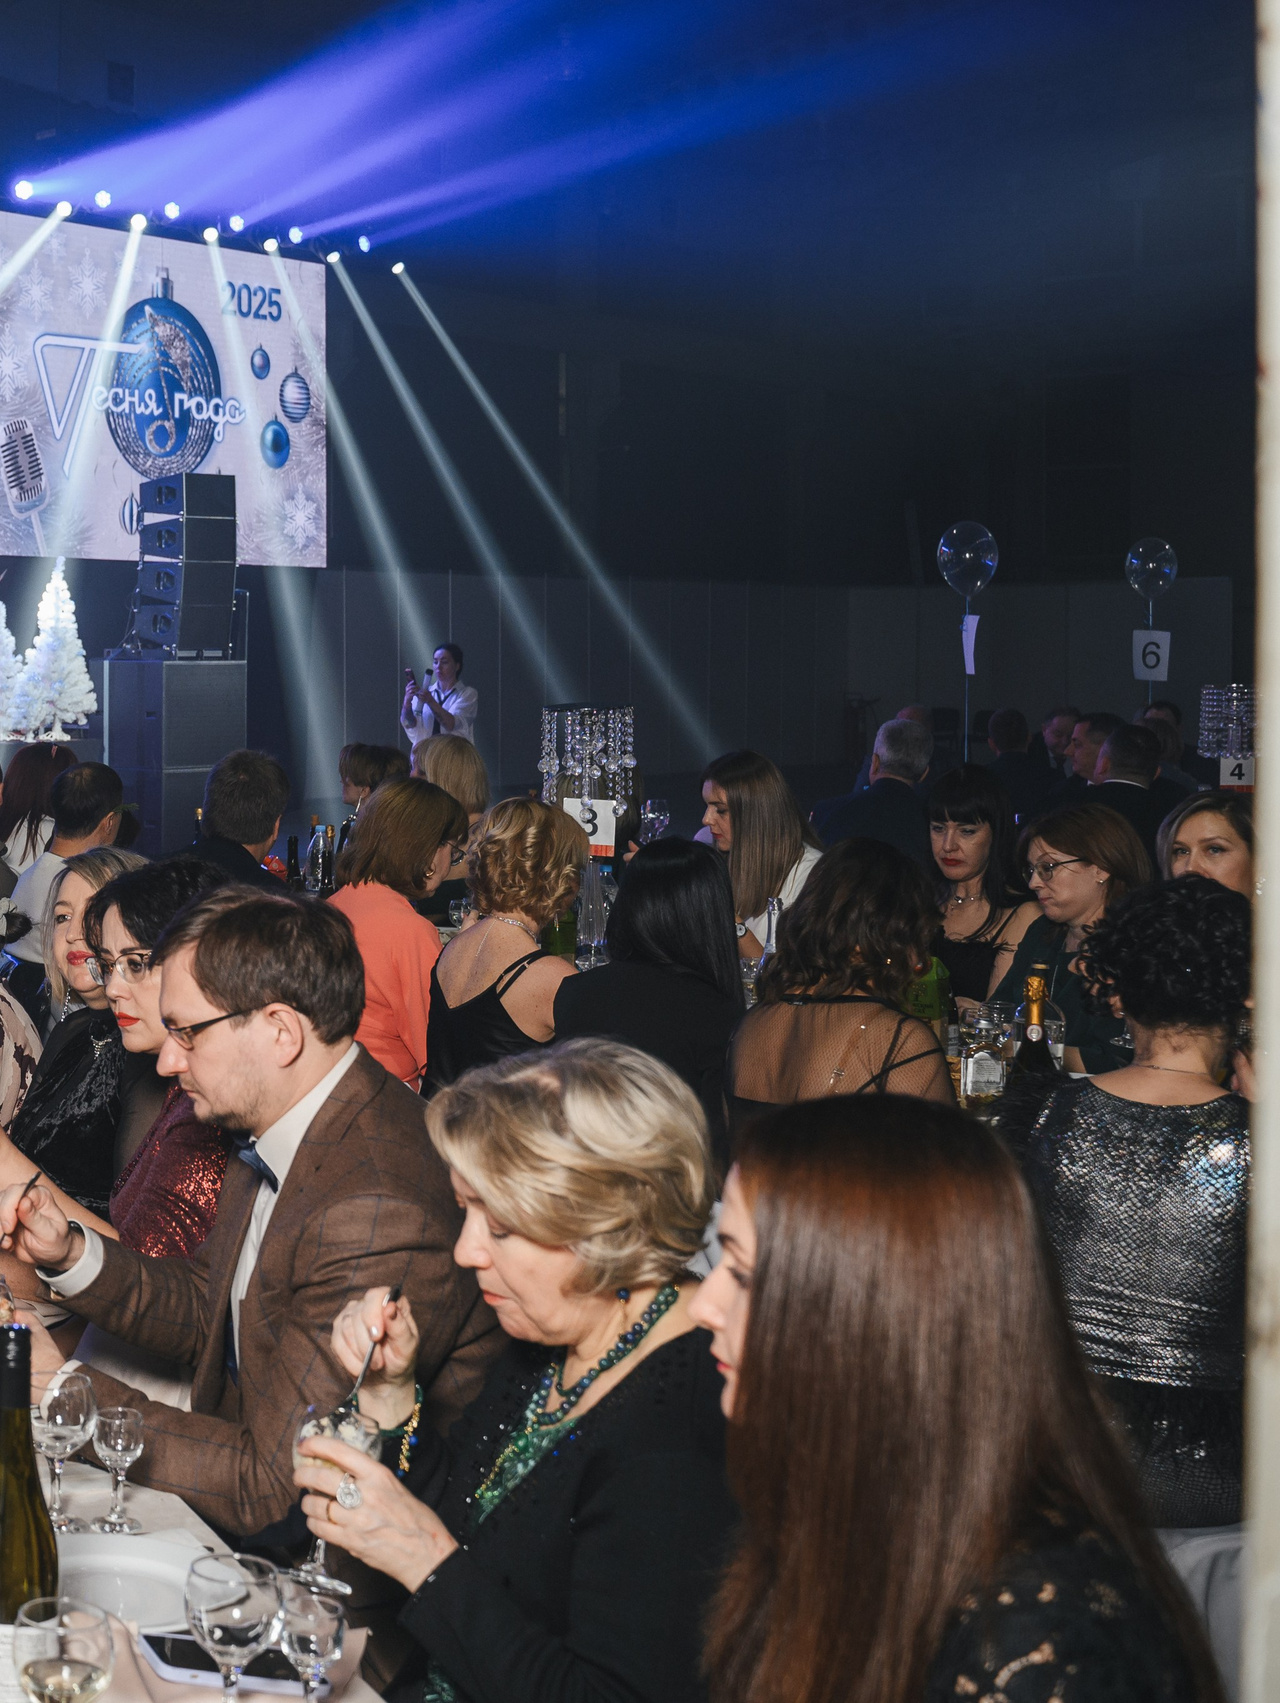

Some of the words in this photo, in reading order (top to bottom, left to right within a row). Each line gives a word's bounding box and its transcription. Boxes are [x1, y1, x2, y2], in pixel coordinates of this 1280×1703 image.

[220, 280, 282, 322] 2025
[173, 391, 246, 442] года
[1141, 641, 1161, 670] 6
[1229, 763, 1245, 781] 4
[582, 808, 599, 837] 3
